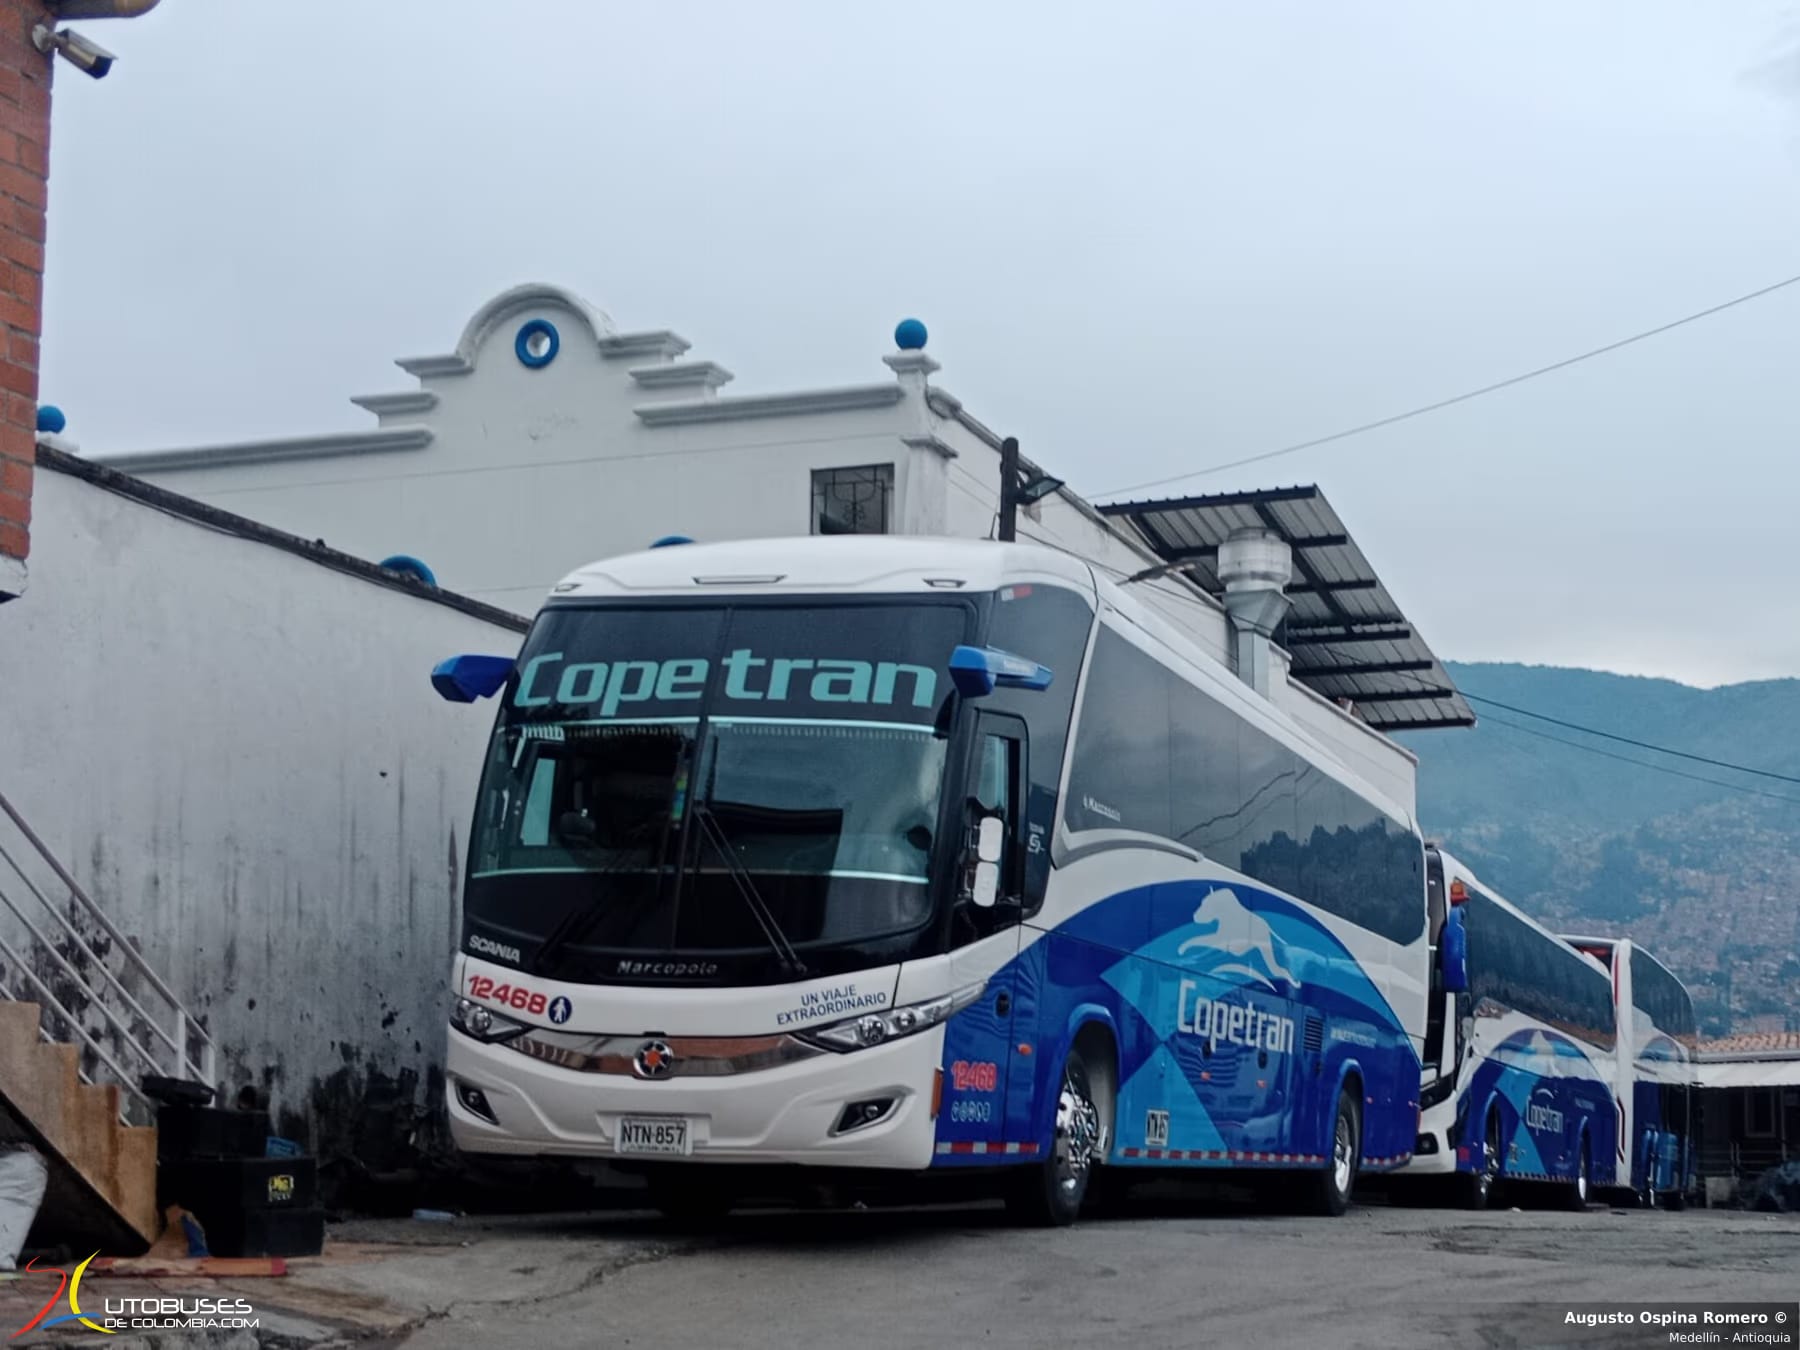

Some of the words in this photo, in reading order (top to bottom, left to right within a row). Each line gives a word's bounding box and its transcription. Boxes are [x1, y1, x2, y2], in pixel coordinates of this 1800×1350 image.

[469, 934, 521, 963] SCANIA
[617, 959, 718, 976] Marcopolo
[468, 974, 548, 1015] 12468
[776, 992, 887, 1025] EXTRAORDINARIO
[801, 992, 819, 1007] UN
[822, 984, 857, 1001] VIAJE
[1177, 978, 1295, 1056] Copetran
